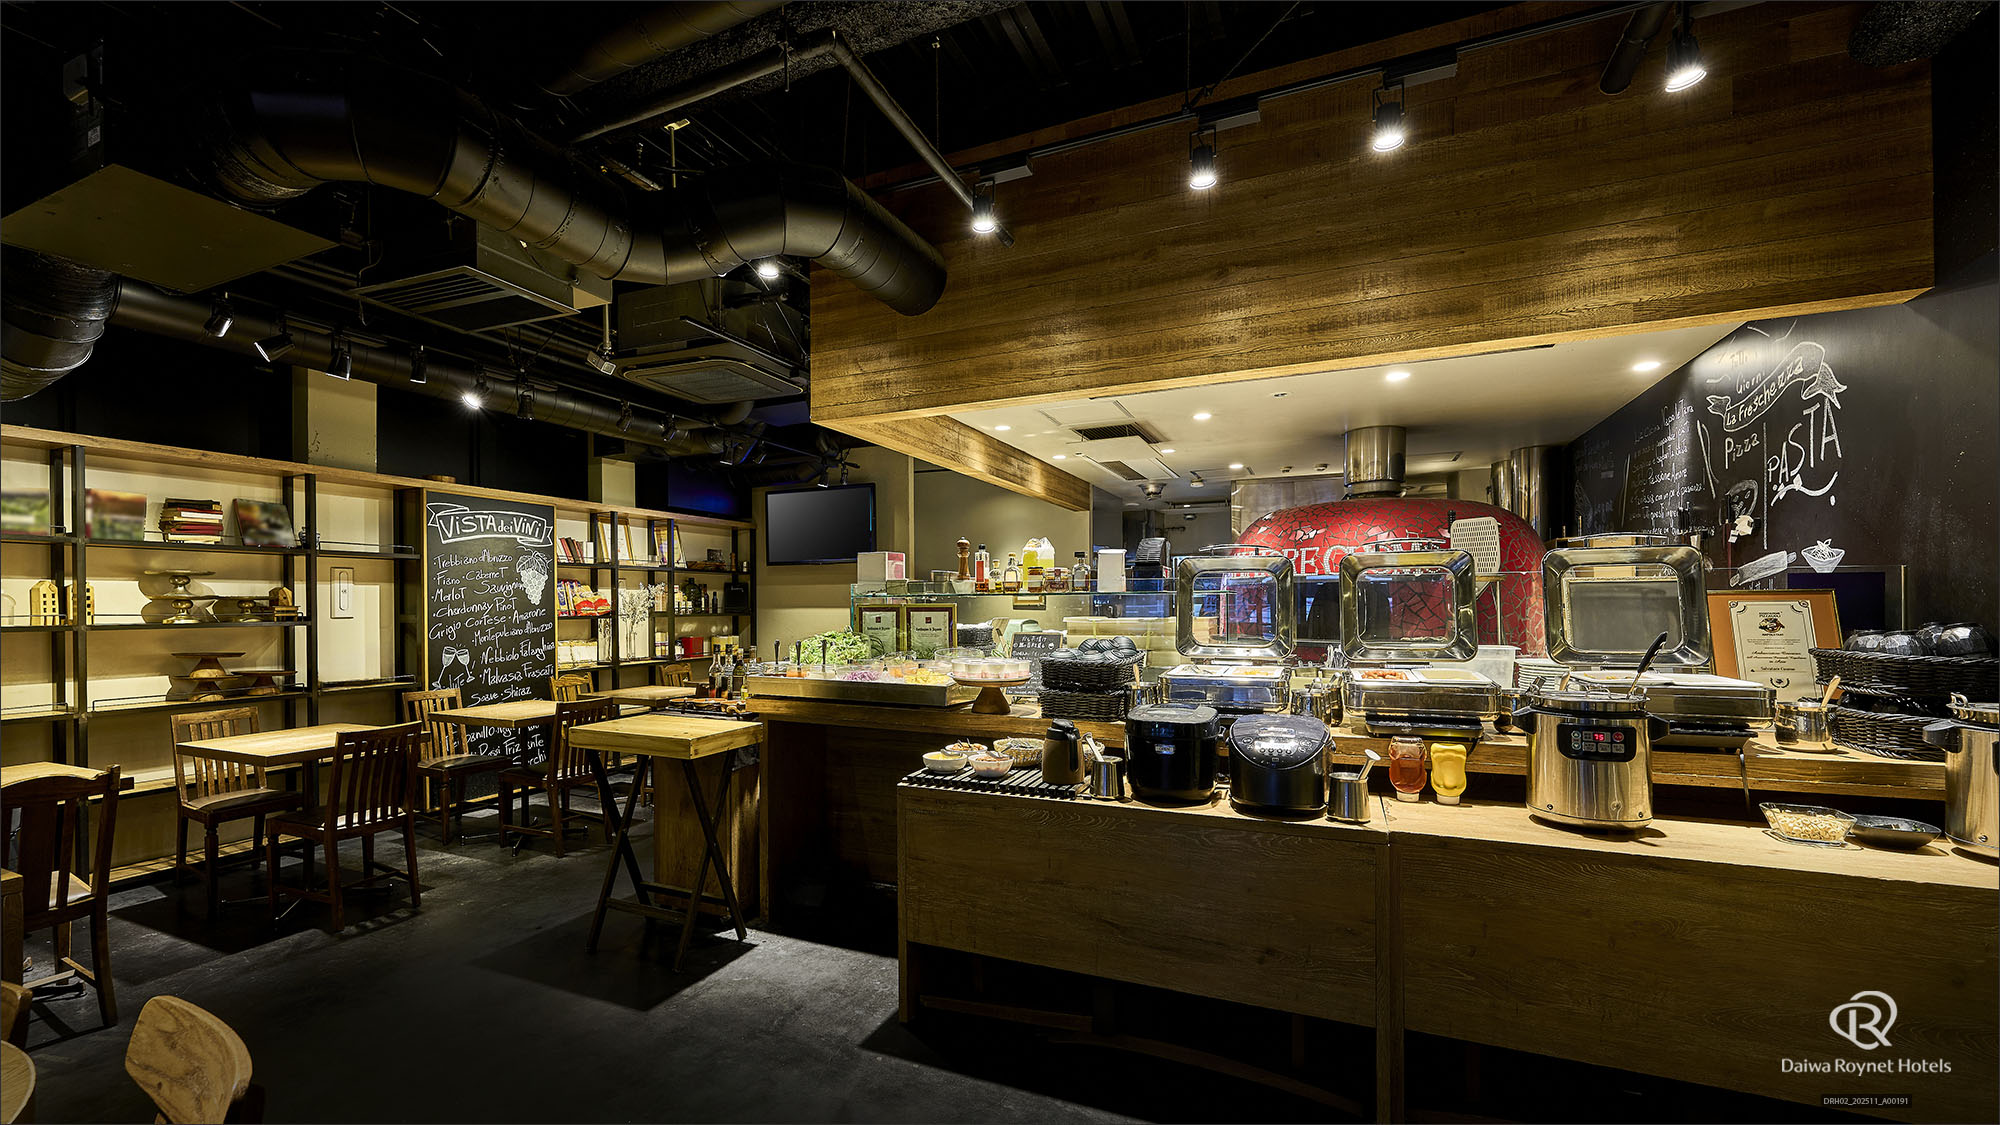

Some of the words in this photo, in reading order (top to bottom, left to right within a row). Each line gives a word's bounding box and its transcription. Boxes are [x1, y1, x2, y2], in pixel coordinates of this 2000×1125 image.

[1726, 412, 1737, 426] La
[1739, 356, 1804, 421] Freschezza
[1736, 370, 1765, 394] Giorni
[1767, 397, 1842, 483] PASTA
[1725, 433, 1760, 470] Pizza
[498, 520, 513, 533] dei
[434, 554, 478, 569] Trebbiano
[436, 570, 460, 586] Fiano
[436, 601, 494, 618] Chardonnay
[429, 621, 462, 640] Grigio
[512, 608, 546, 624] Amarone
[481, 646, 520, 665] Nebbiolo
[482, 667, 522, 686] Malvasia
[468, 692, 499, 708] Soave
[502, 684, 532, 700] Shiraz
[1593, 733, 1605, 741] 75
